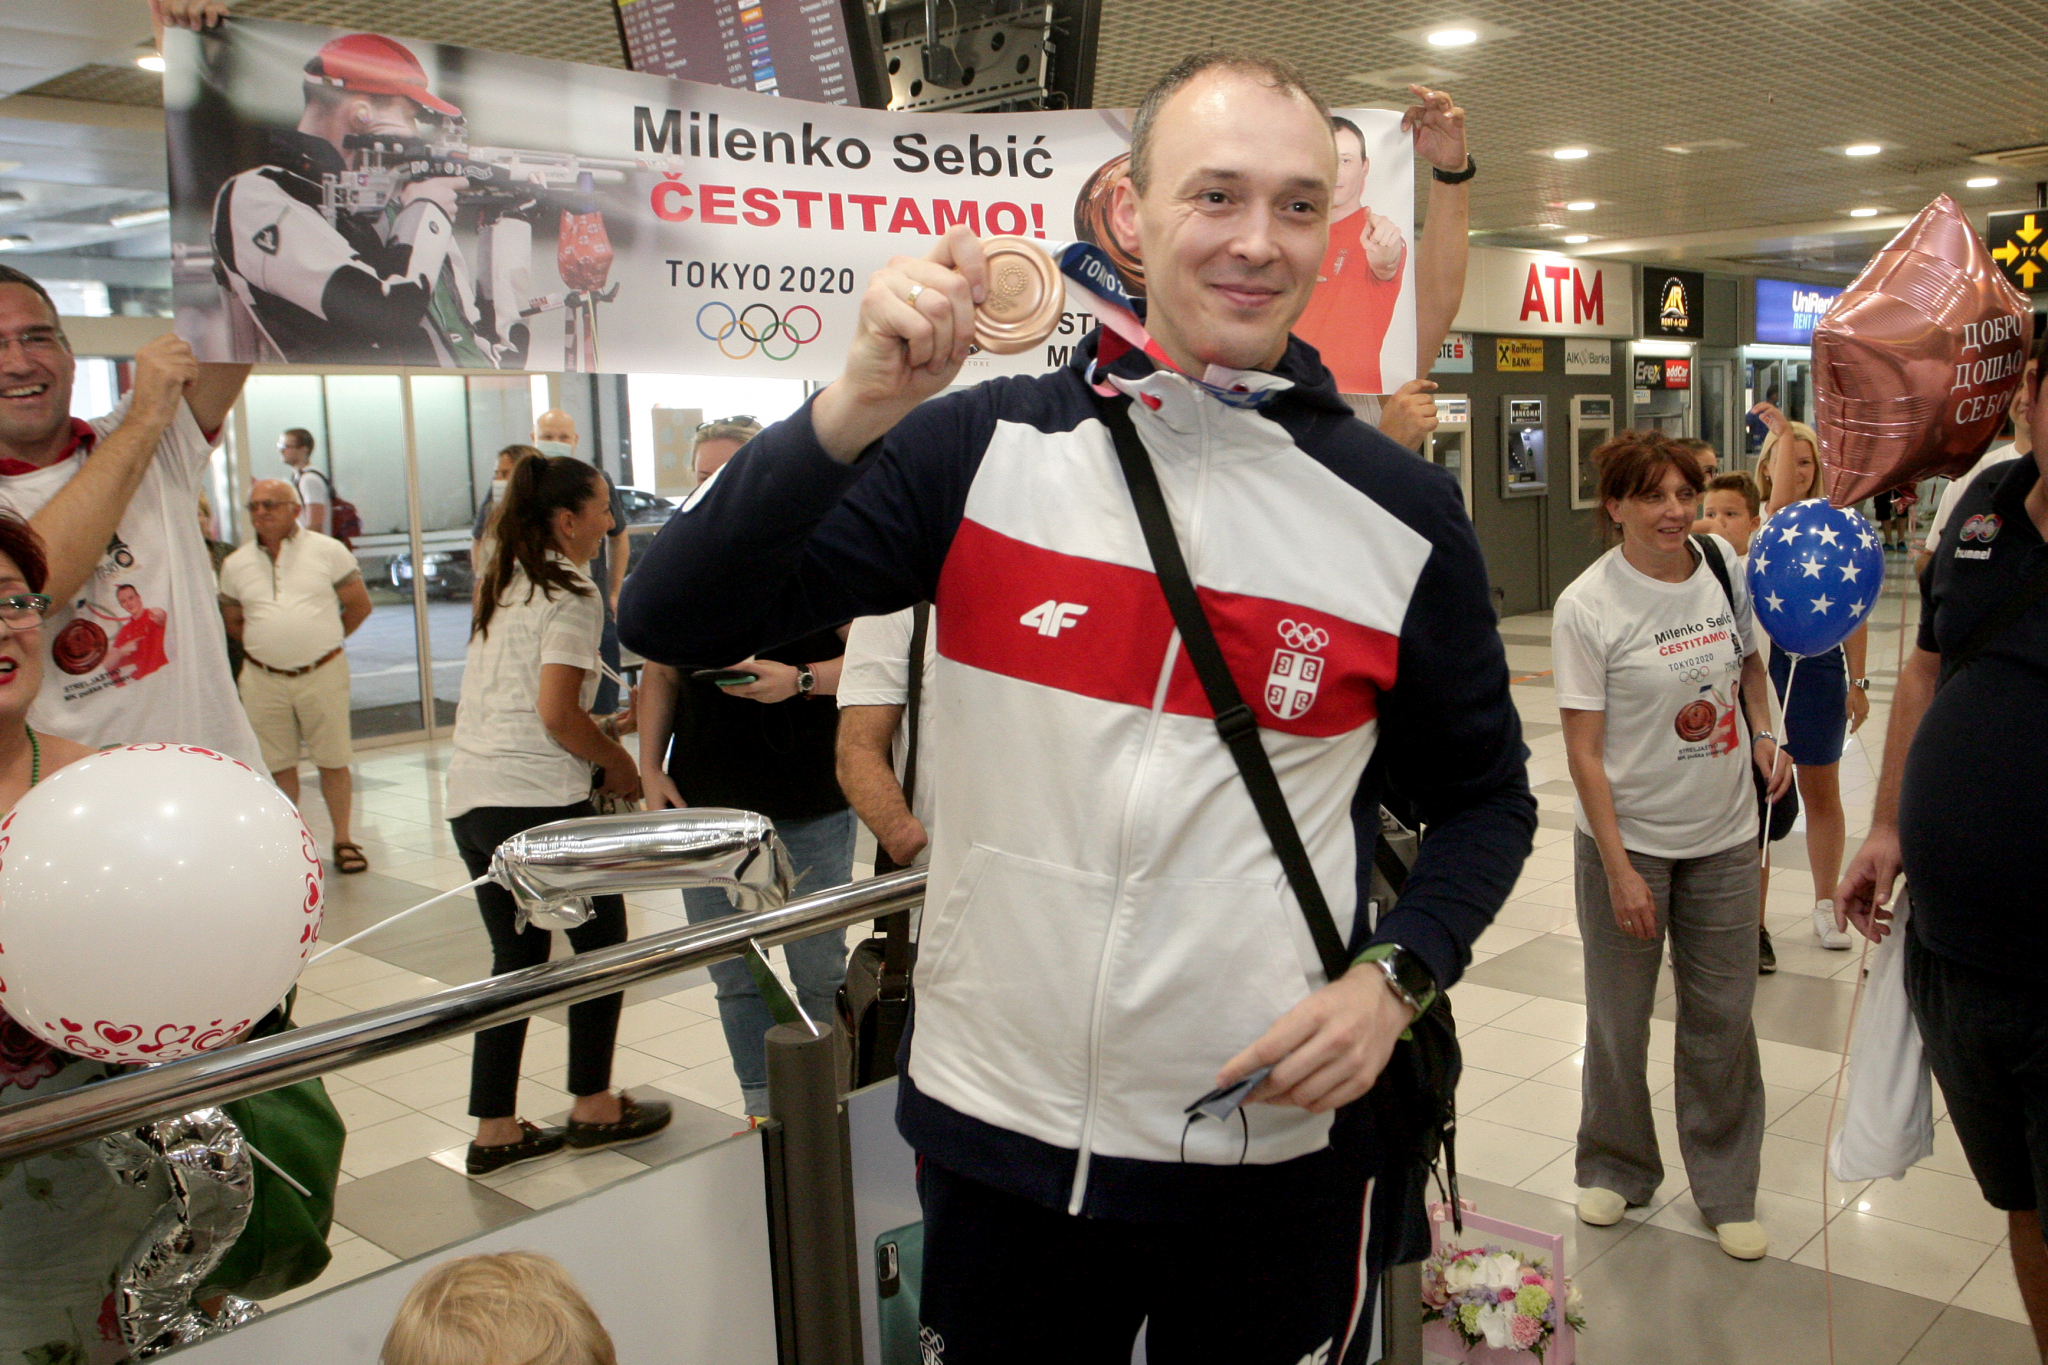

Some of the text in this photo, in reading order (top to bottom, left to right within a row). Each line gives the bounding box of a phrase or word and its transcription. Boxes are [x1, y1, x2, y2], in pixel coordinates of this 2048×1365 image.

[633, 106, 1055, 180] Milenko Sebić
[650, 171, 1047, 240] ČESTITAMO!
[666, 259, 855, 294] TOKYO 2020
[1519, 262, 1604, 326] ATM
[1793, 313, 1812, 330] RENT
[1961, 311, 2022, 356] ДОБРО
[1511, 343, 1543, 355] Raiffeisen
[1511, 357, 1531, 368] BANK
[1566, 351, 1610, 365] AIK Banka
[1950, 349, 2023, 395] ДОШАО
[1954, 546, 1992, 560] hummel
[1019, 599, 1089, 639] 4F
[1654, 623, 1704, 646] Milenko
[1659, 630, 1730, 657] ČESTITAMO!
[1668, 653, 1714, 672] TOKYO 2020
